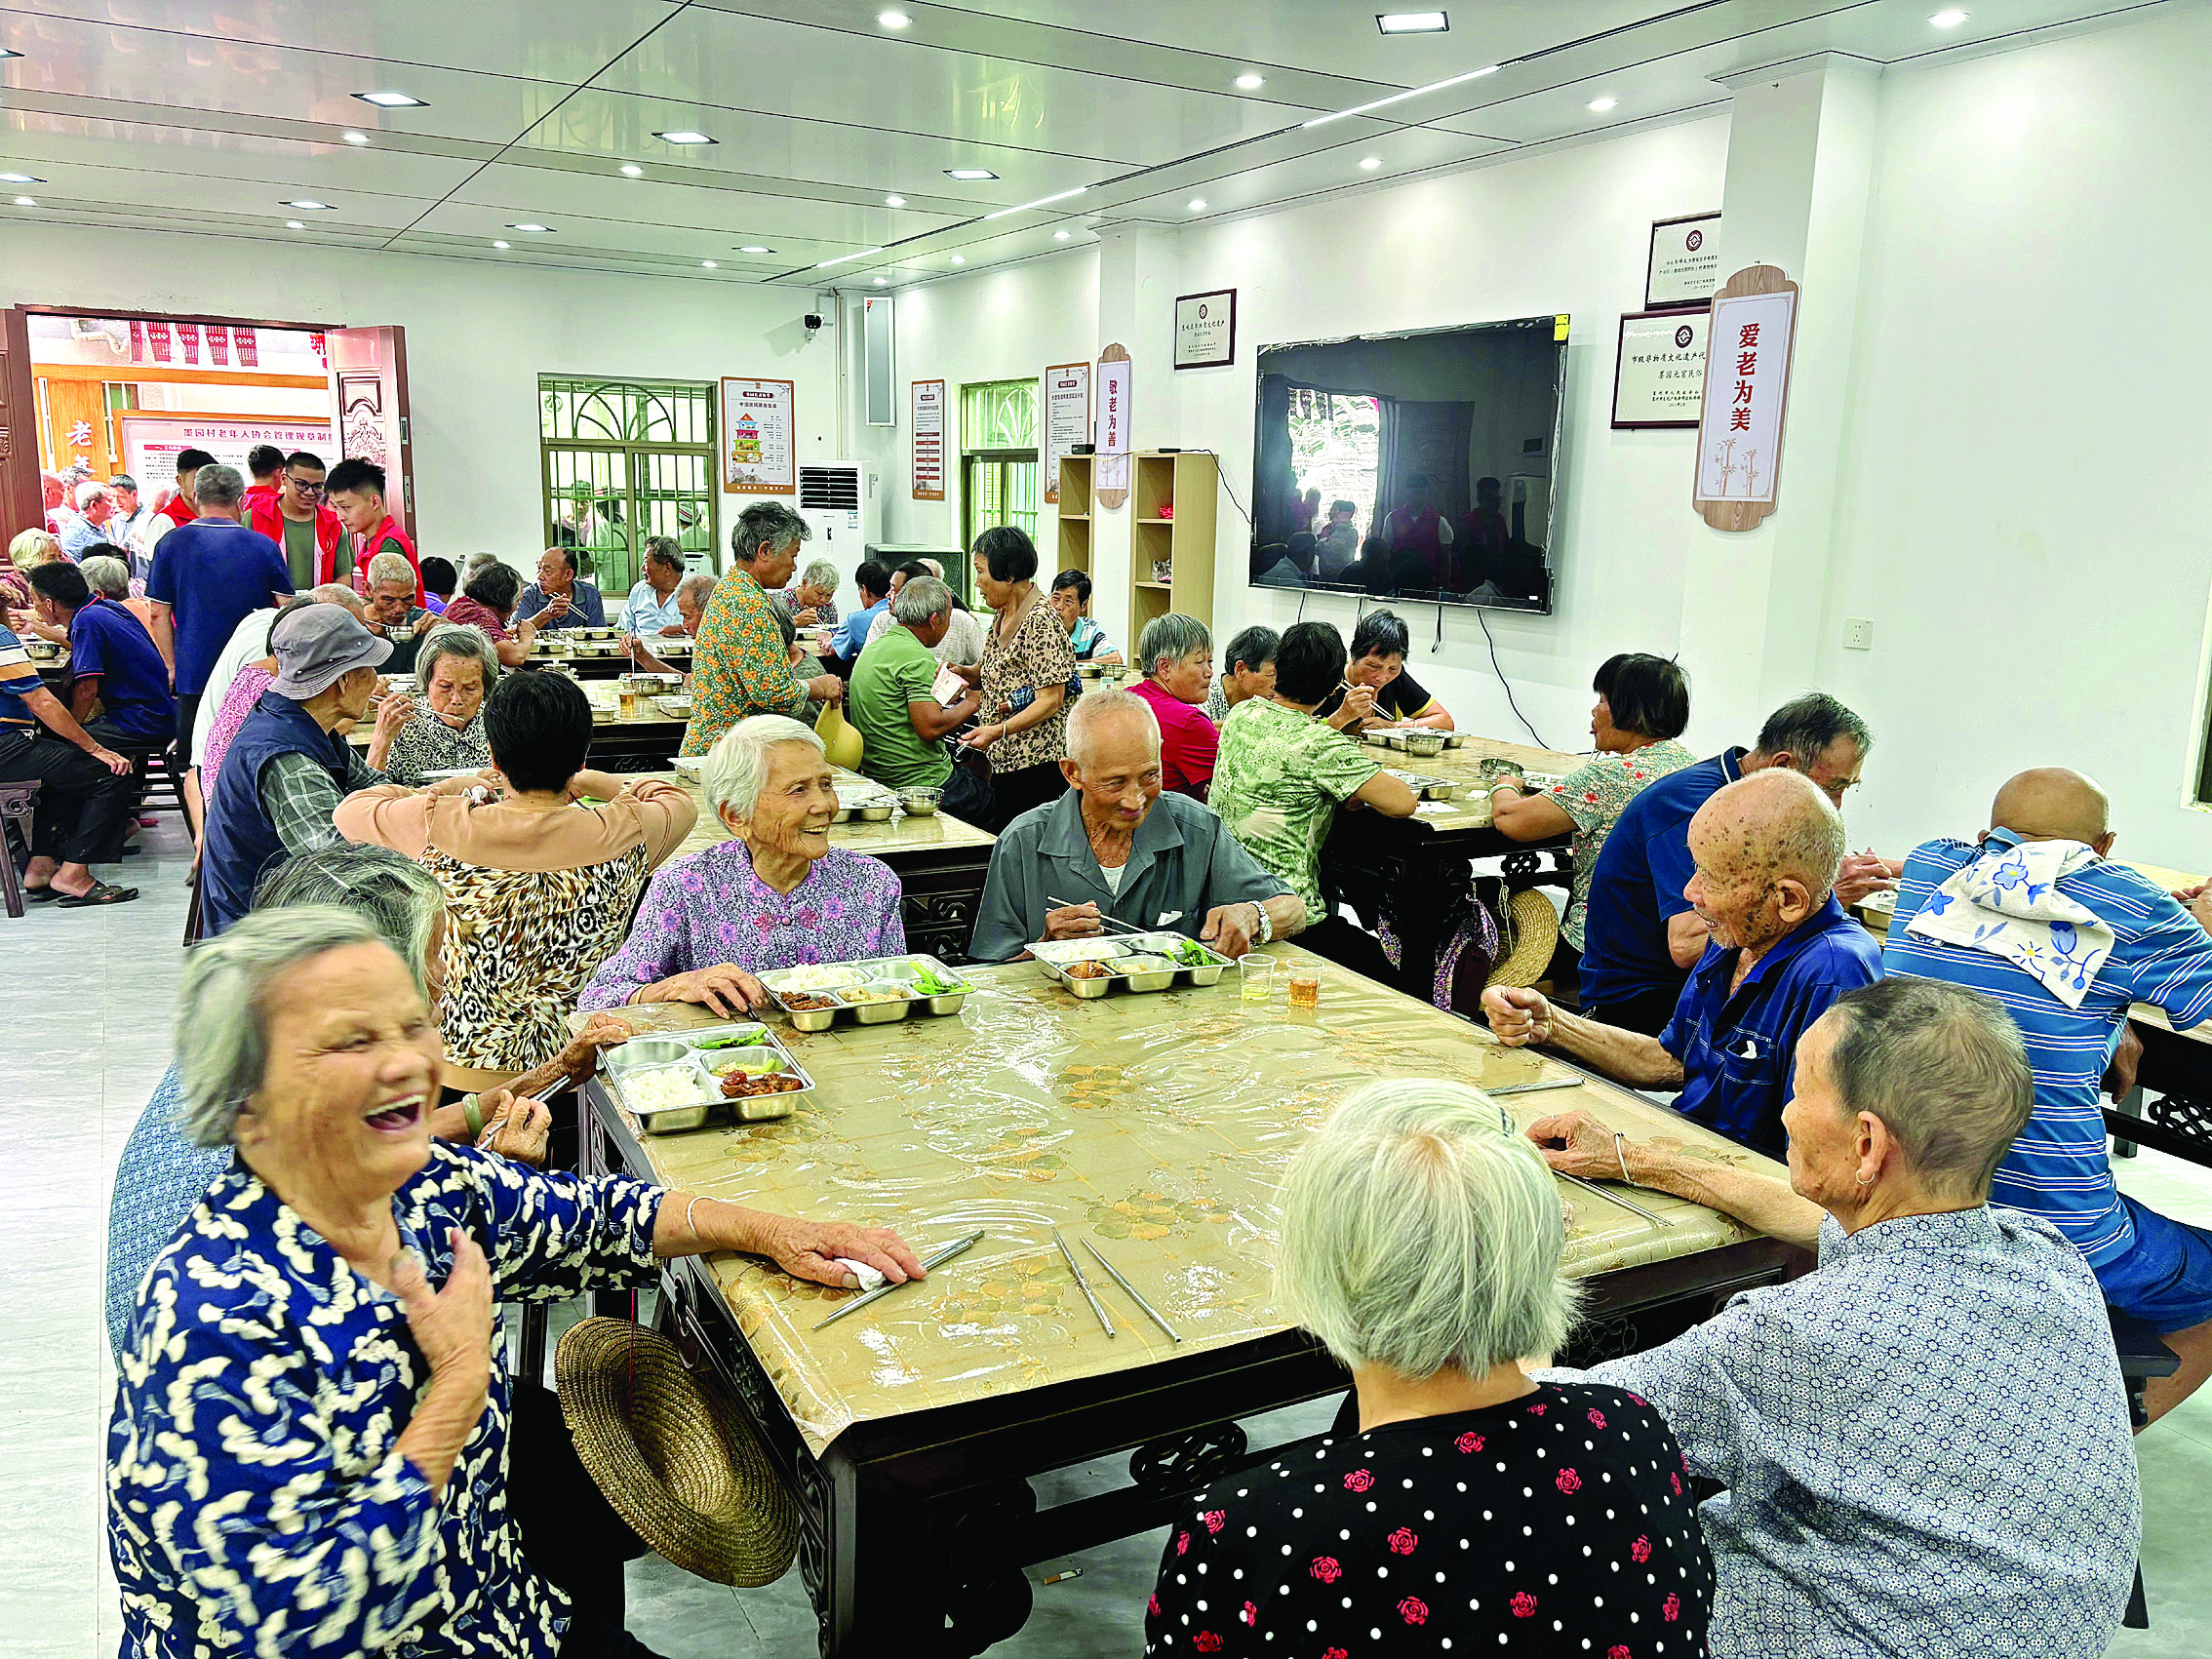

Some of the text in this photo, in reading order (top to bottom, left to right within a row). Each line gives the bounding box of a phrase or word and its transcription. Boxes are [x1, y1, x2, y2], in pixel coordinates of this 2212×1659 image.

[1631, 351, 1706, 364] 市级非物质文化遗产代
[1729, 322, 1761, 432] 爱老为美
[1107, 379, 1118, 447] 敬老为善
